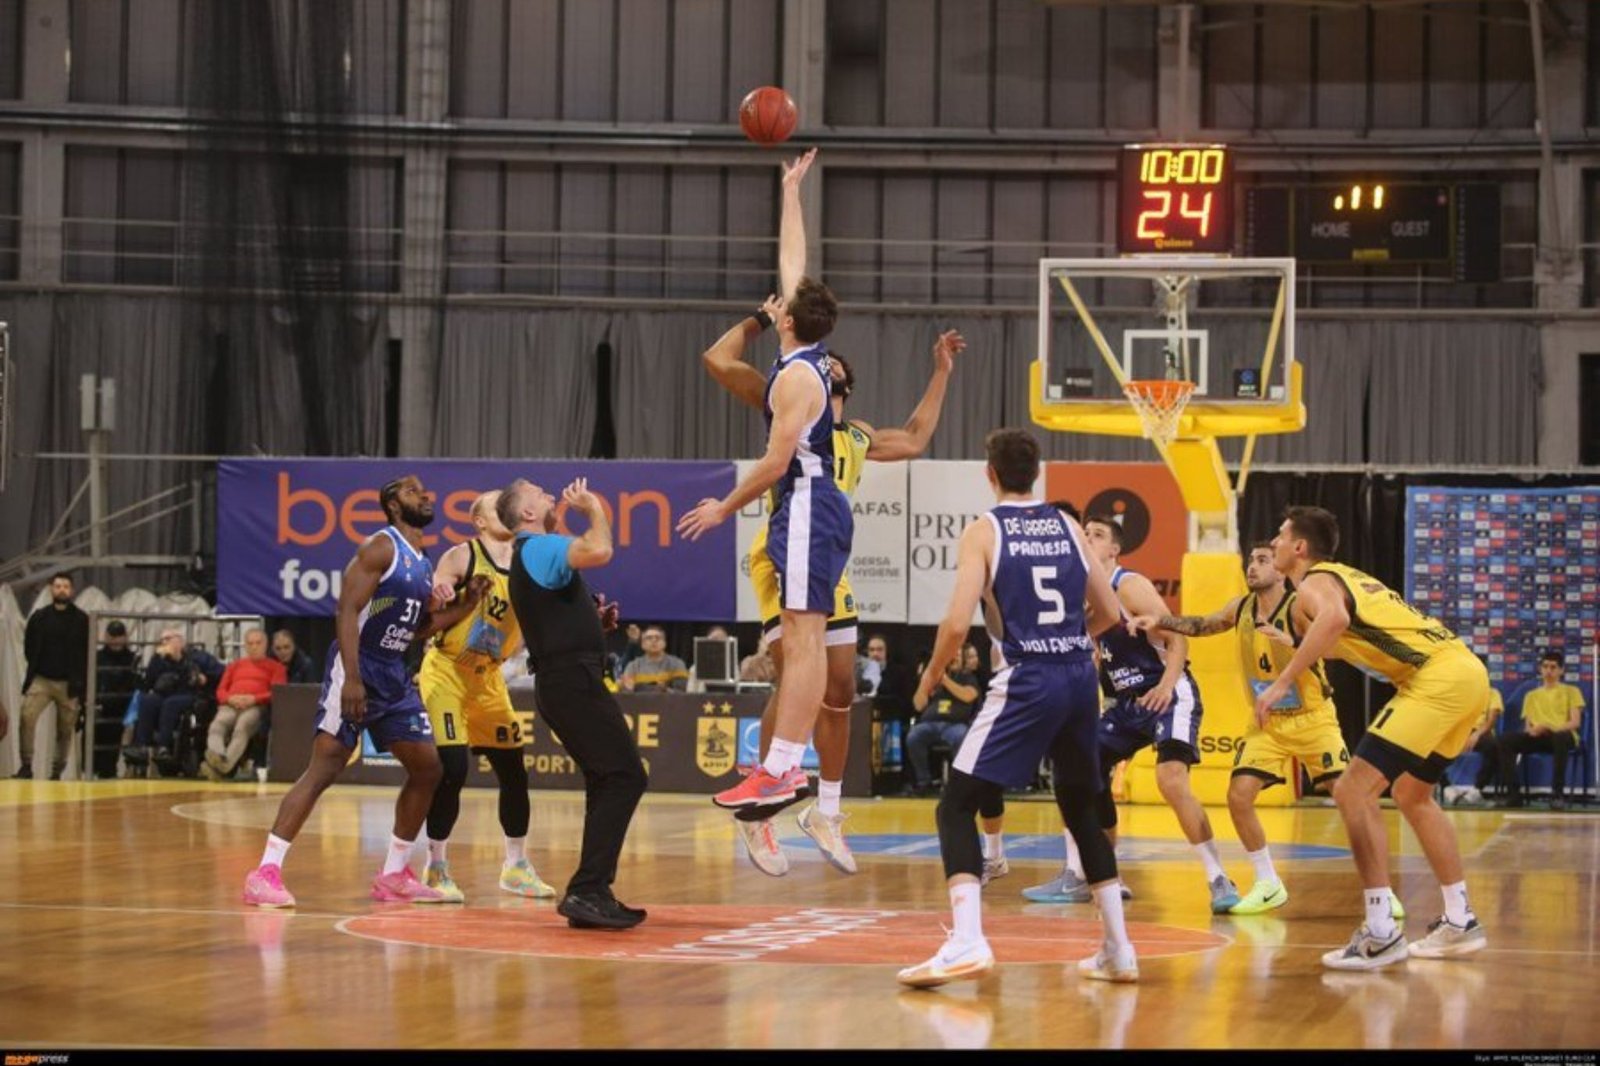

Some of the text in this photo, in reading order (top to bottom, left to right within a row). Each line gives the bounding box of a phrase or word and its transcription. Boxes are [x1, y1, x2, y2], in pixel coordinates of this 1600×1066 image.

[1141, 150, 1223, 183] 10:00
[1137, 190, 1212, 238] 24
[1311, 222, 1350, 238] HOME
[1391, 220, 1430, 237] GUEST
[278, 471, 671, 546] beson
[1009, 541, 1071, 556] PAMESA
[853, 568, 899, 577] HYGIENE
[1031, 566, 1065, 625] 5
[1259, 652, 1271, 673] 4
